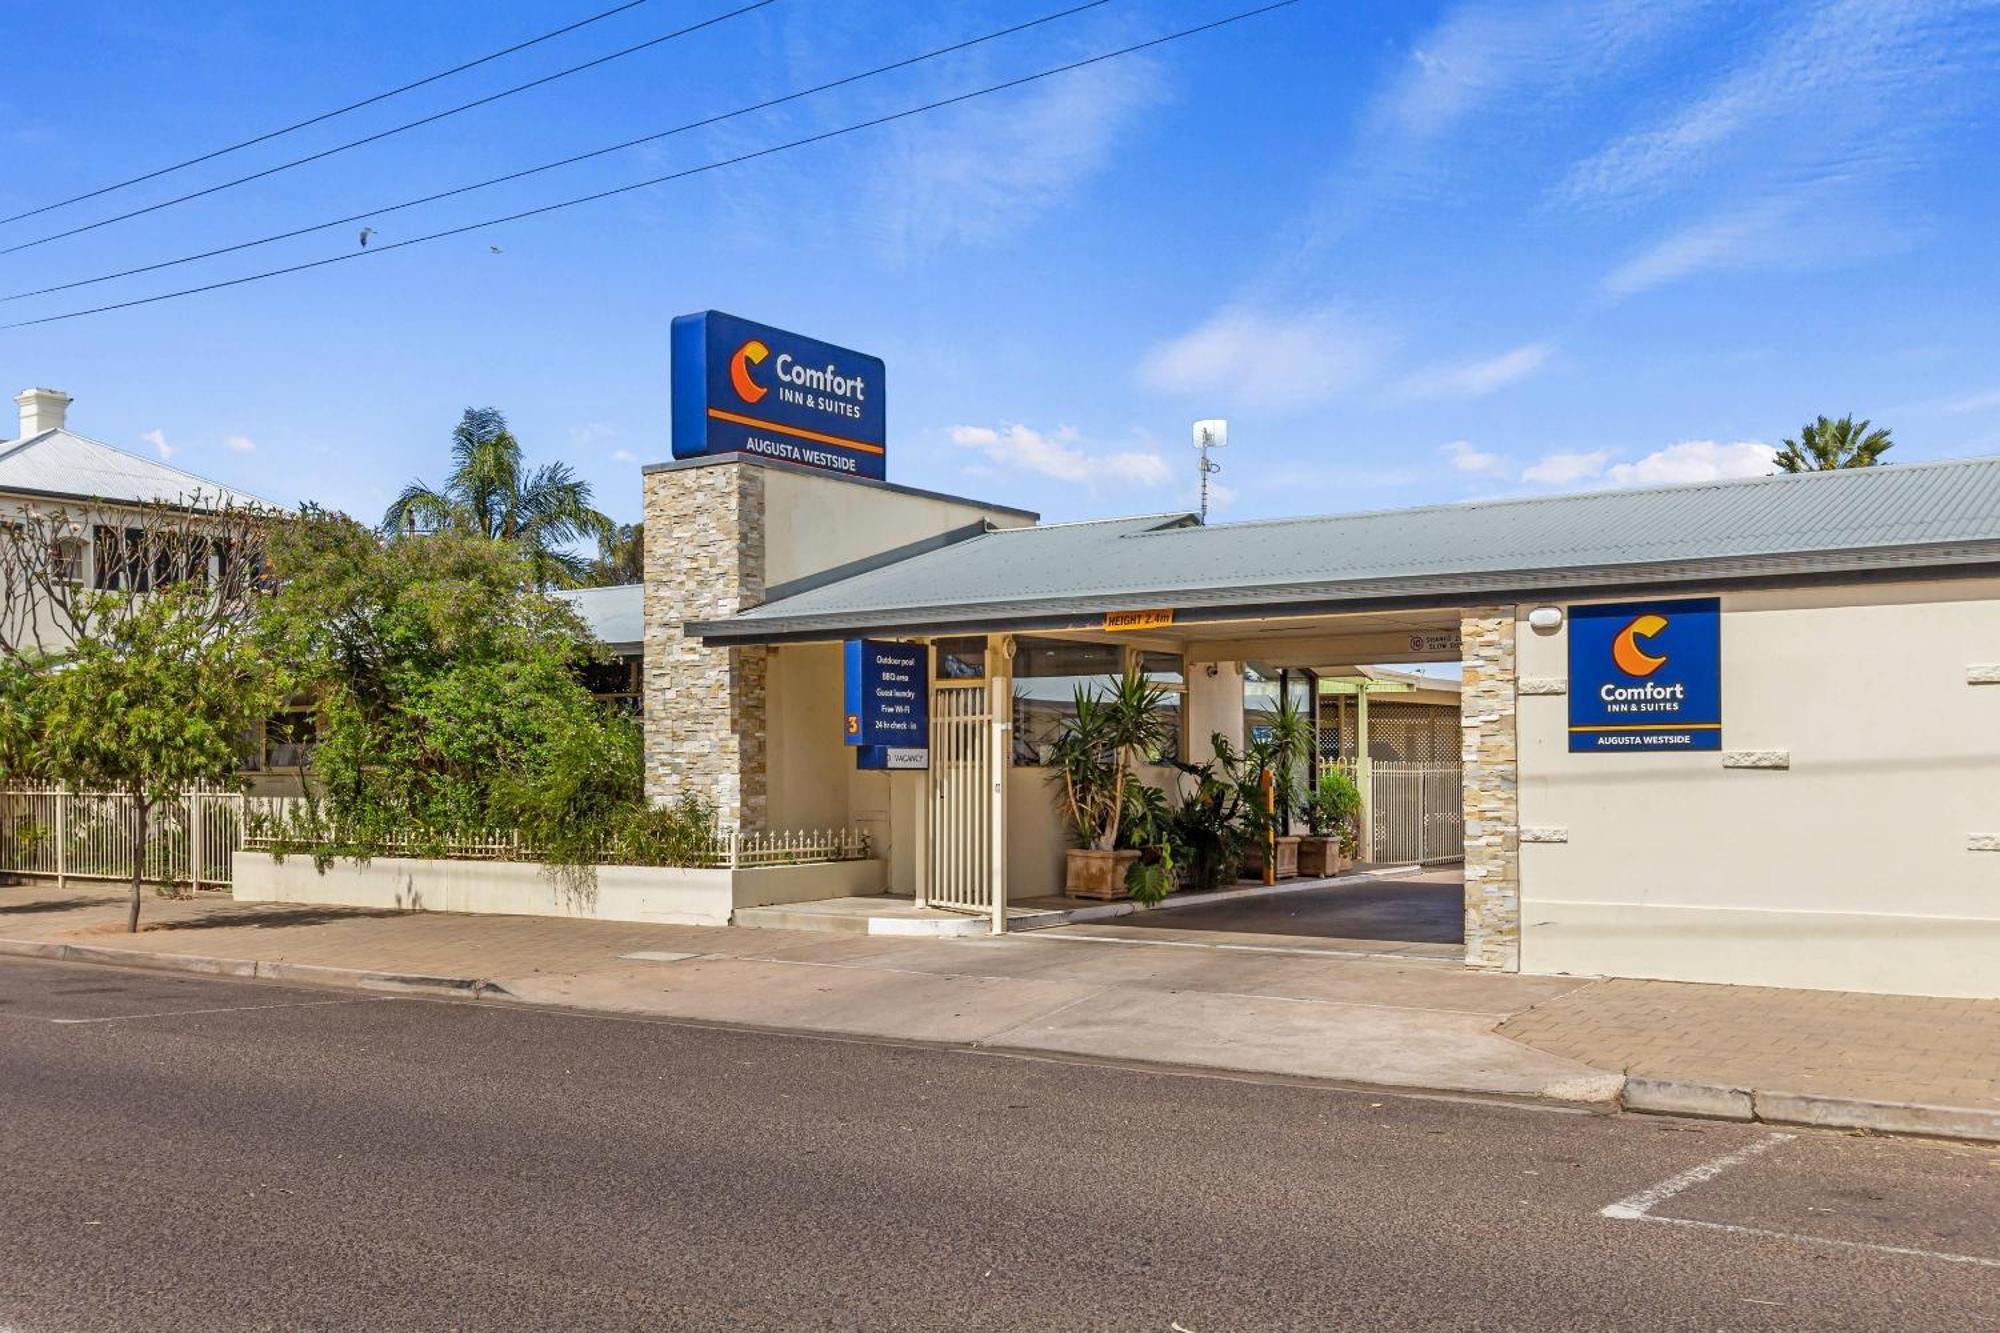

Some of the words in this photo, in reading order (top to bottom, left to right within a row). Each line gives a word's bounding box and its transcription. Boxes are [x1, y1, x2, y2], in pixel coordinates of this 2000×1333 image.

[776, 354, 864, 400] Comfort
[779, 387, 803, 405] INN
[806, 394, 815, 408] &
[818, 398, 860, 419] SUITES
[746, 437, 801, 460] AUGUSTA
[802, 448, 856, 472] WESTSIDE
[1108, 614, 1140, 626] HEIGHT
[1144, 613, 1170, 624] 2.4m
[876, 655, 901, 665] Outdoor
[901, 658, 915, 667] pool
[882, 671, 896, 681] BBQ
[896, 674, 909, 682] area
[876, 688, 893, 697] Guest
[894, 688, 915, 700] laundry
[1600, 682, 1684, 701] Comfort
[881, 704, 894, 713] Free
[1607, 703, 1628, 712] INN
[1630, 703, 1638, 712] &
[1640, 702, 1679, 712] SUITES
[848, 716, 857, 733] 3
[875, 720, 883, 729] 24
[883, 721, 890, 729] hr
[1597, 736, 1642, 745] AUGUSTA
[1643, 735, 1691, 744] WESTSIDE
[895, 754, 924, 762] VACANCY
